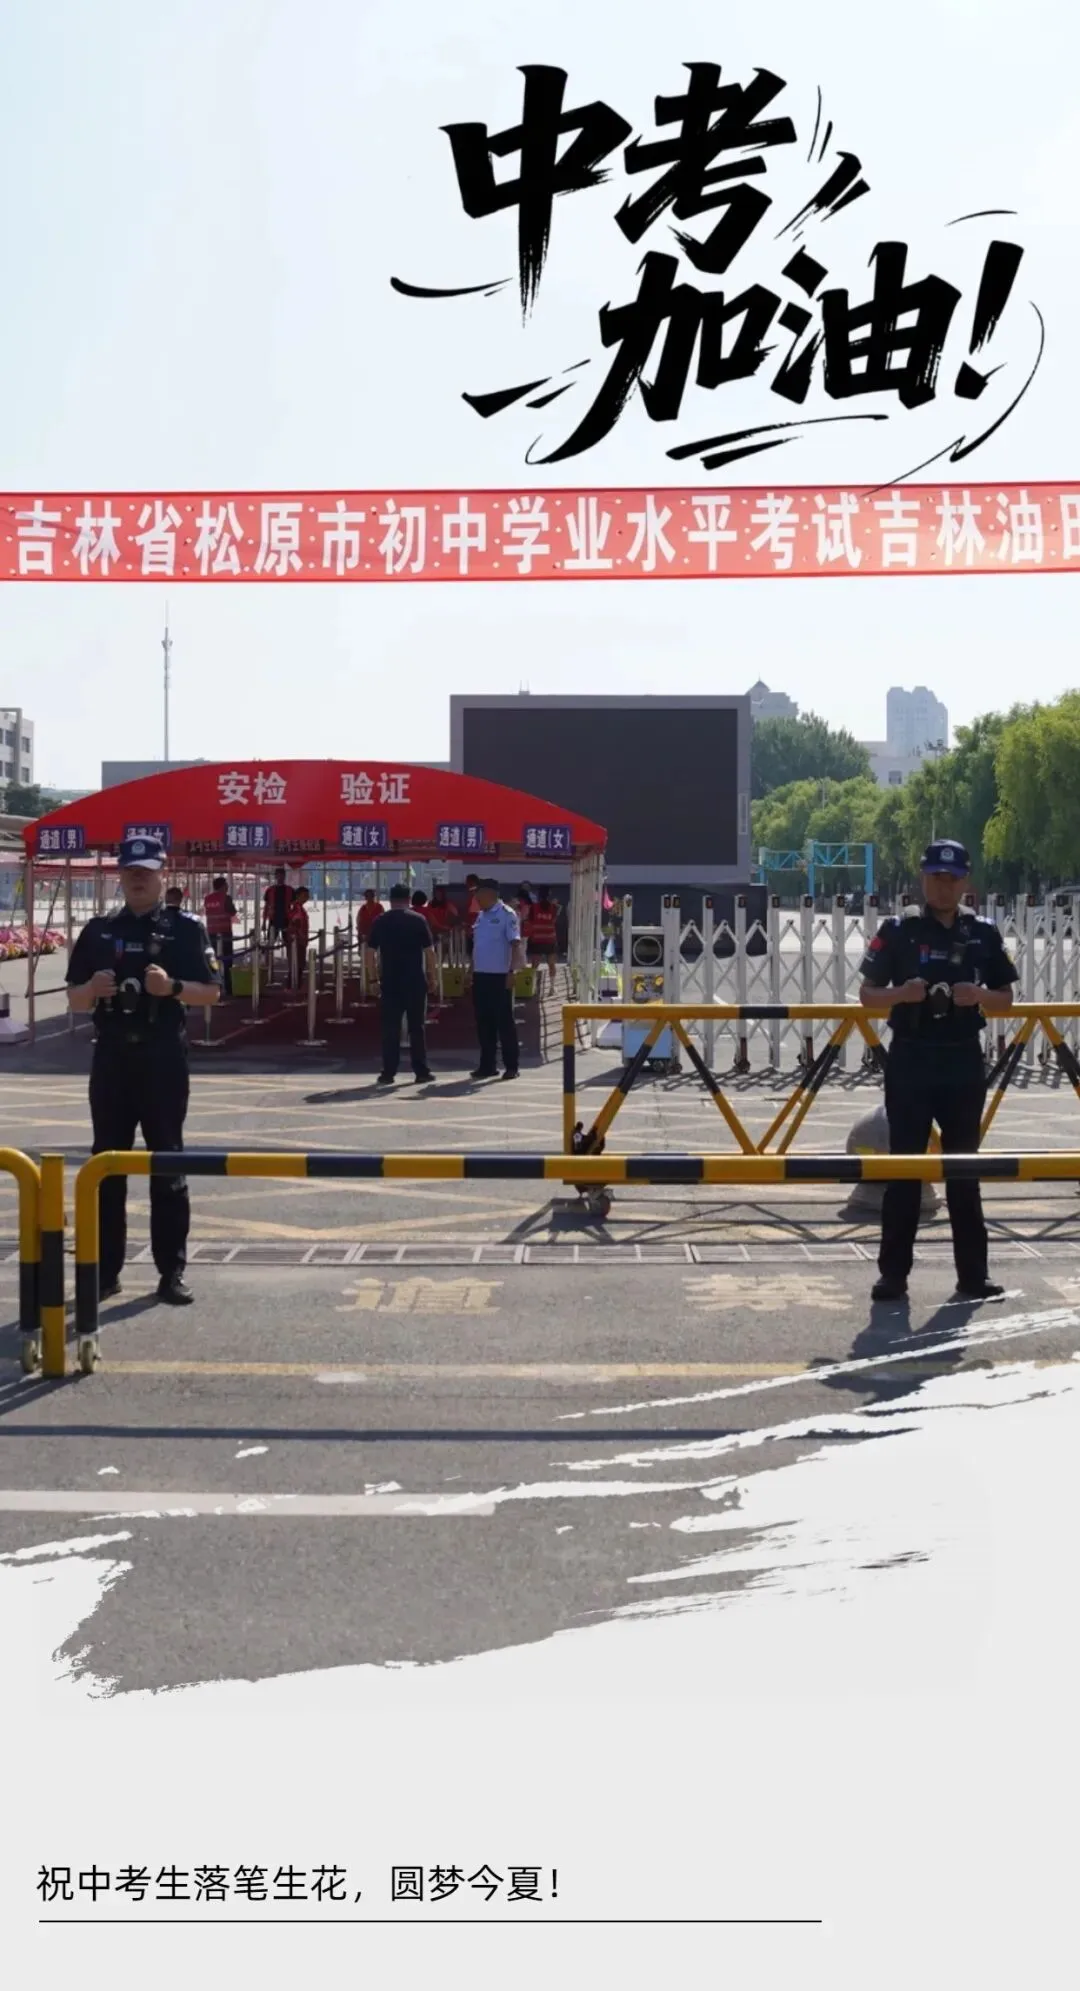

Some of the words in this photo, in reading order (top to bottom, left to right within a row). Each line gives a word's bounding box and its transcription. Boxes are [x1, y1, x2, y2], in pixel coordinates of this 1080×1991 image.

[217, 772, 287, 805] 安检
[340, 772, 411, 805] 验证
[227, 826, 270, 846] 通道(男)
[342, 826, 386, 846] 通道(女)
[440, 827, 483, 847] 通道(男)
[526, 828, 570, 848] 通道(女)
